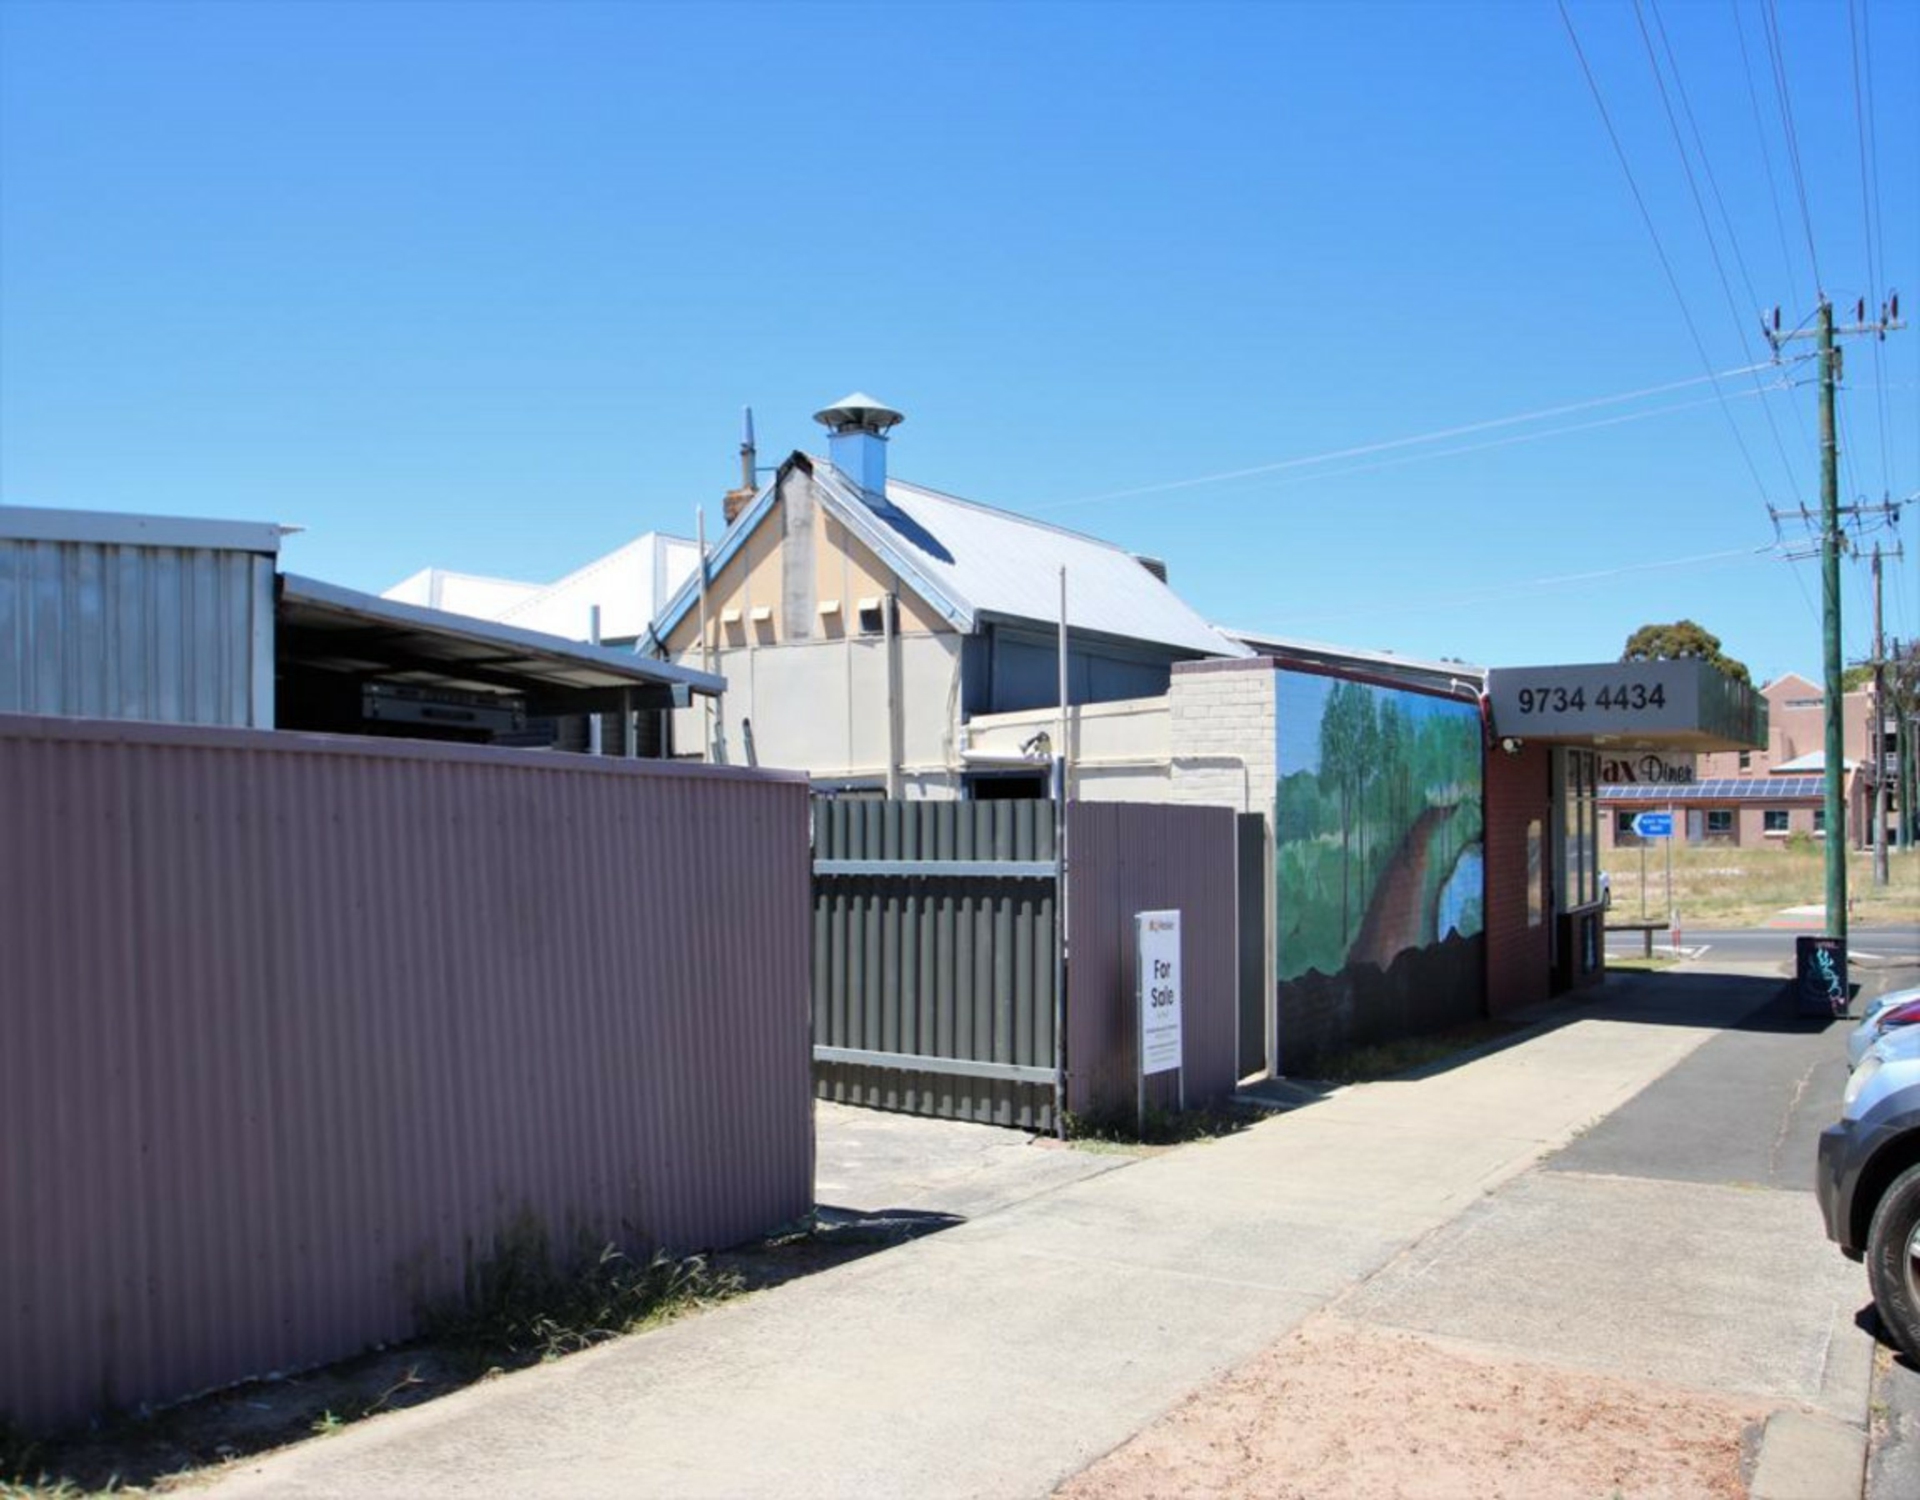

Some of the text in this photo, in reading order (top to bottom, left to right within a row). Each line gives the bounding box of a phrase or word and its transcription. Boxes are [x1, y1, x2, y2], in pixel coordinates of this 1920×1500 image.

[1518, 682, 1666, 714] 9734 4434
[1154, 959, 1171, 980] For
[1151, 986, 1174, 1008] Sale
